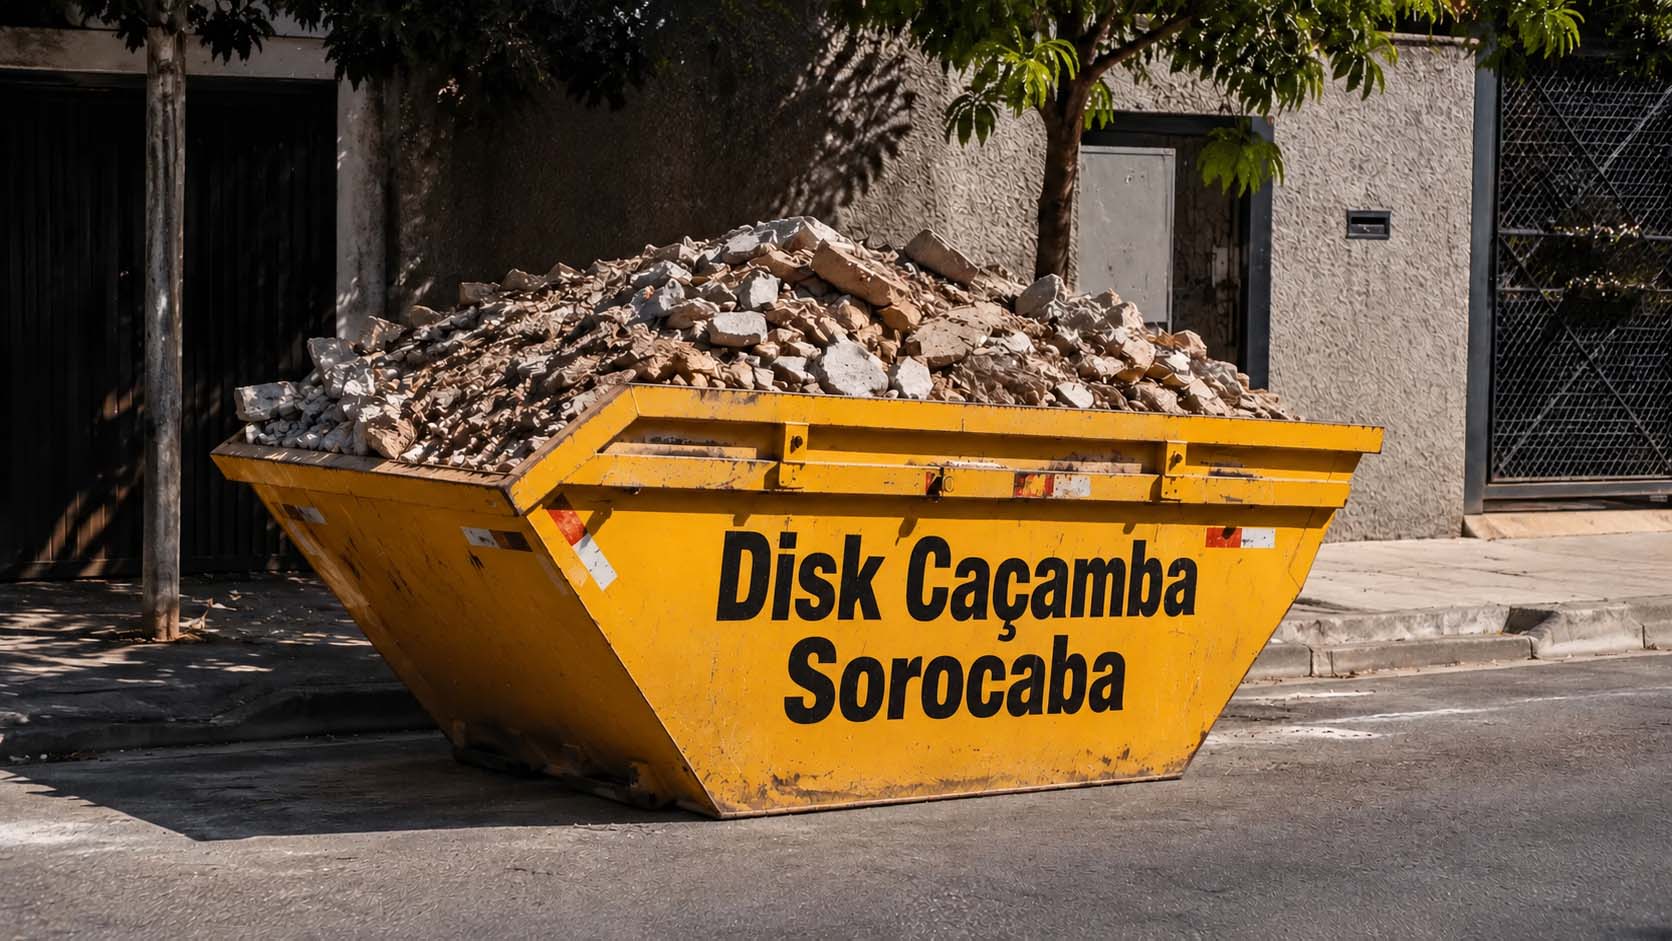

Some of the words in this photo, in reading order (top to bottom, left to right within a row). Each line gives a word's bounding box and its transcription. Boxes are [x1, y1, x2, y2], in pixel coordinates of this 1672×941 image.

[716, 530, 885, 621] Disk
[906, 535, 1198, 641] Caçamba
[784, 635, 1126, 724] Sorocaba
